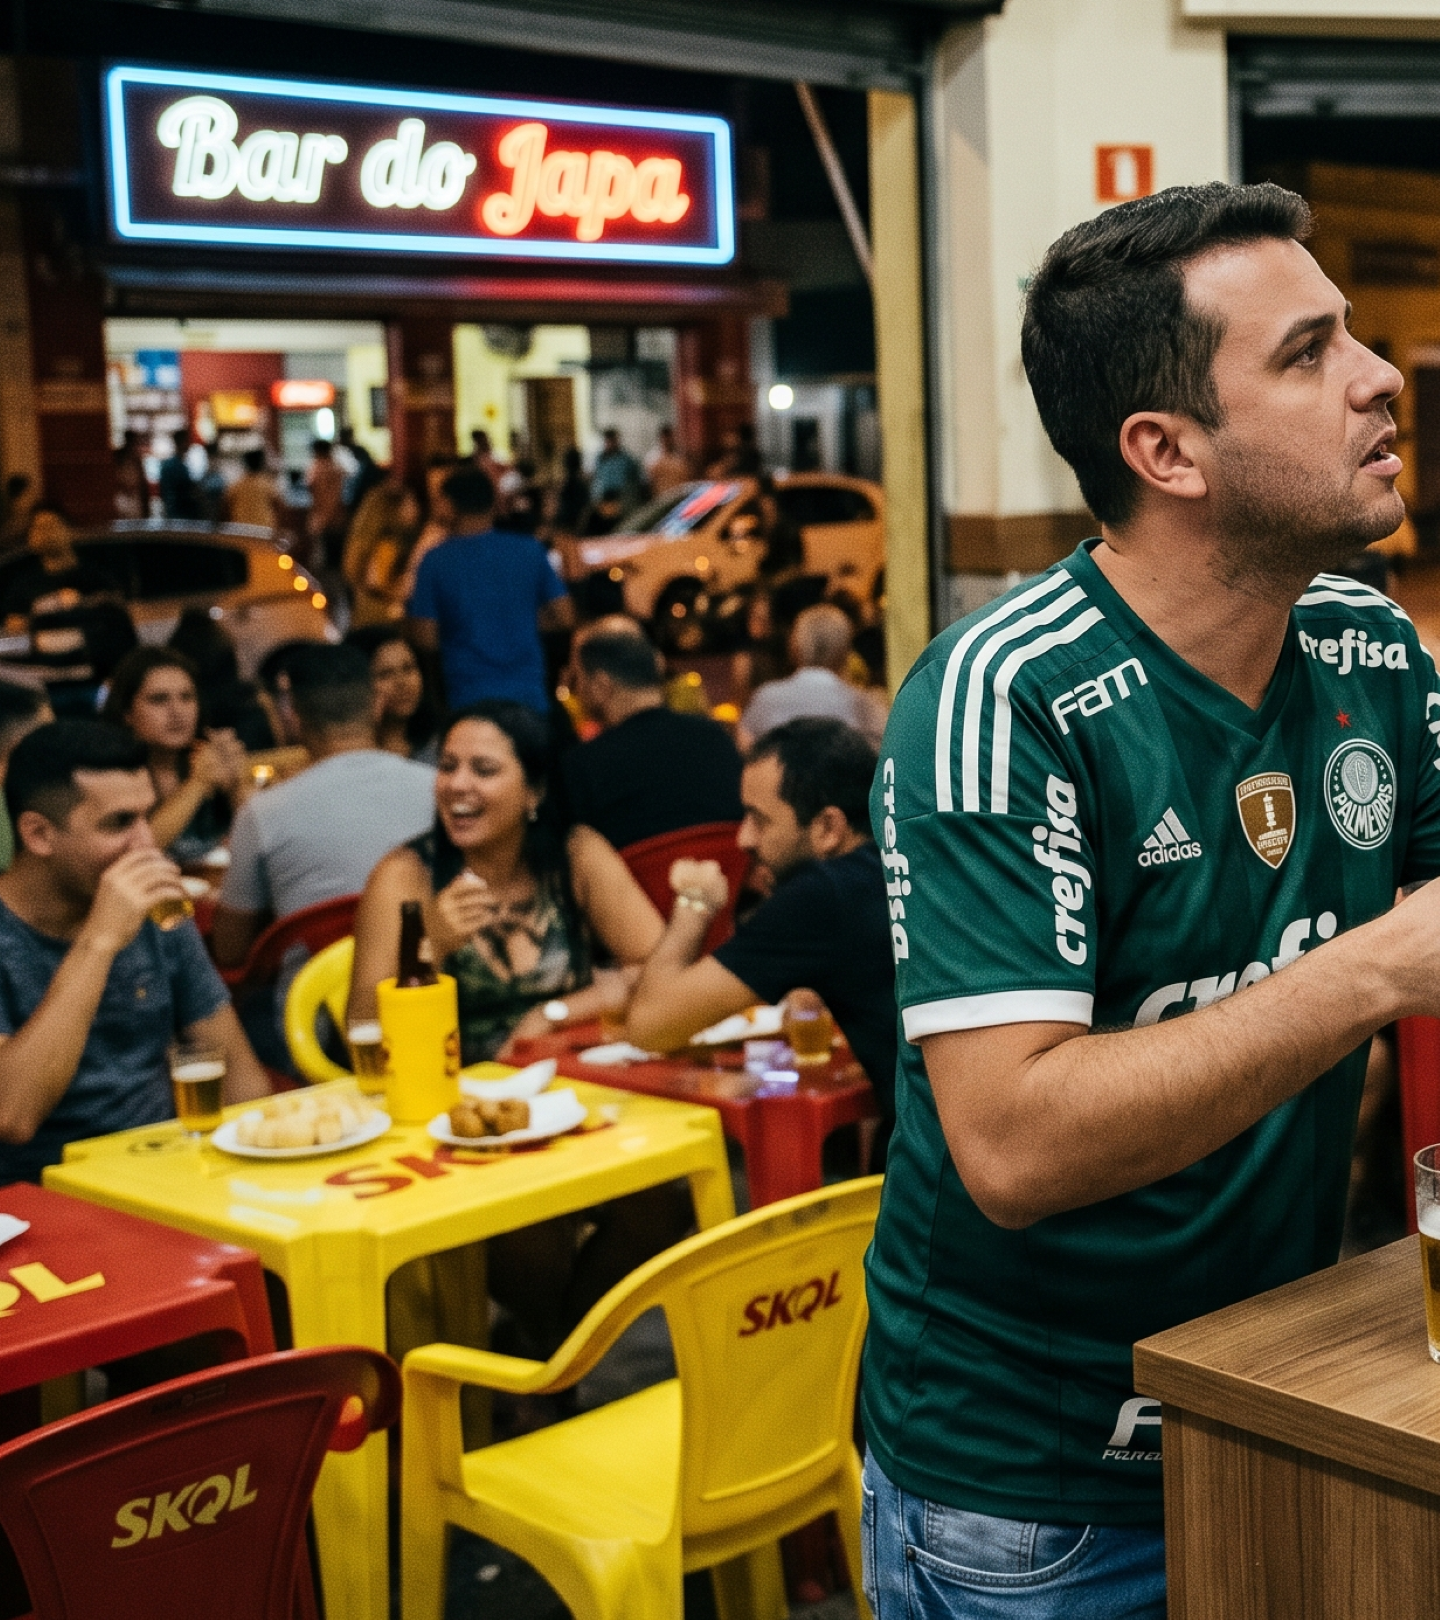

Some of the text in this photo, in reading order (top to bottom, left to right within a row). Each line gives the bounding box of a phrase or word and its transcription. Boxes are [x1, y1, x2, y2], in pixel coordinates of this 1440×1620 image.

[157, 95, 690, 242] Bar do Japa
[1137, 841, 1203, 867] adidas
[1332, 783, 1393, 840] PALMEIRAS
[880, 757, 912, 965] crefisa
[1032, 773, 1092, 966] crefisa
[738, 1268, 844, 1338] SKOL
[111, 1462, 259, 1549] SKOL
